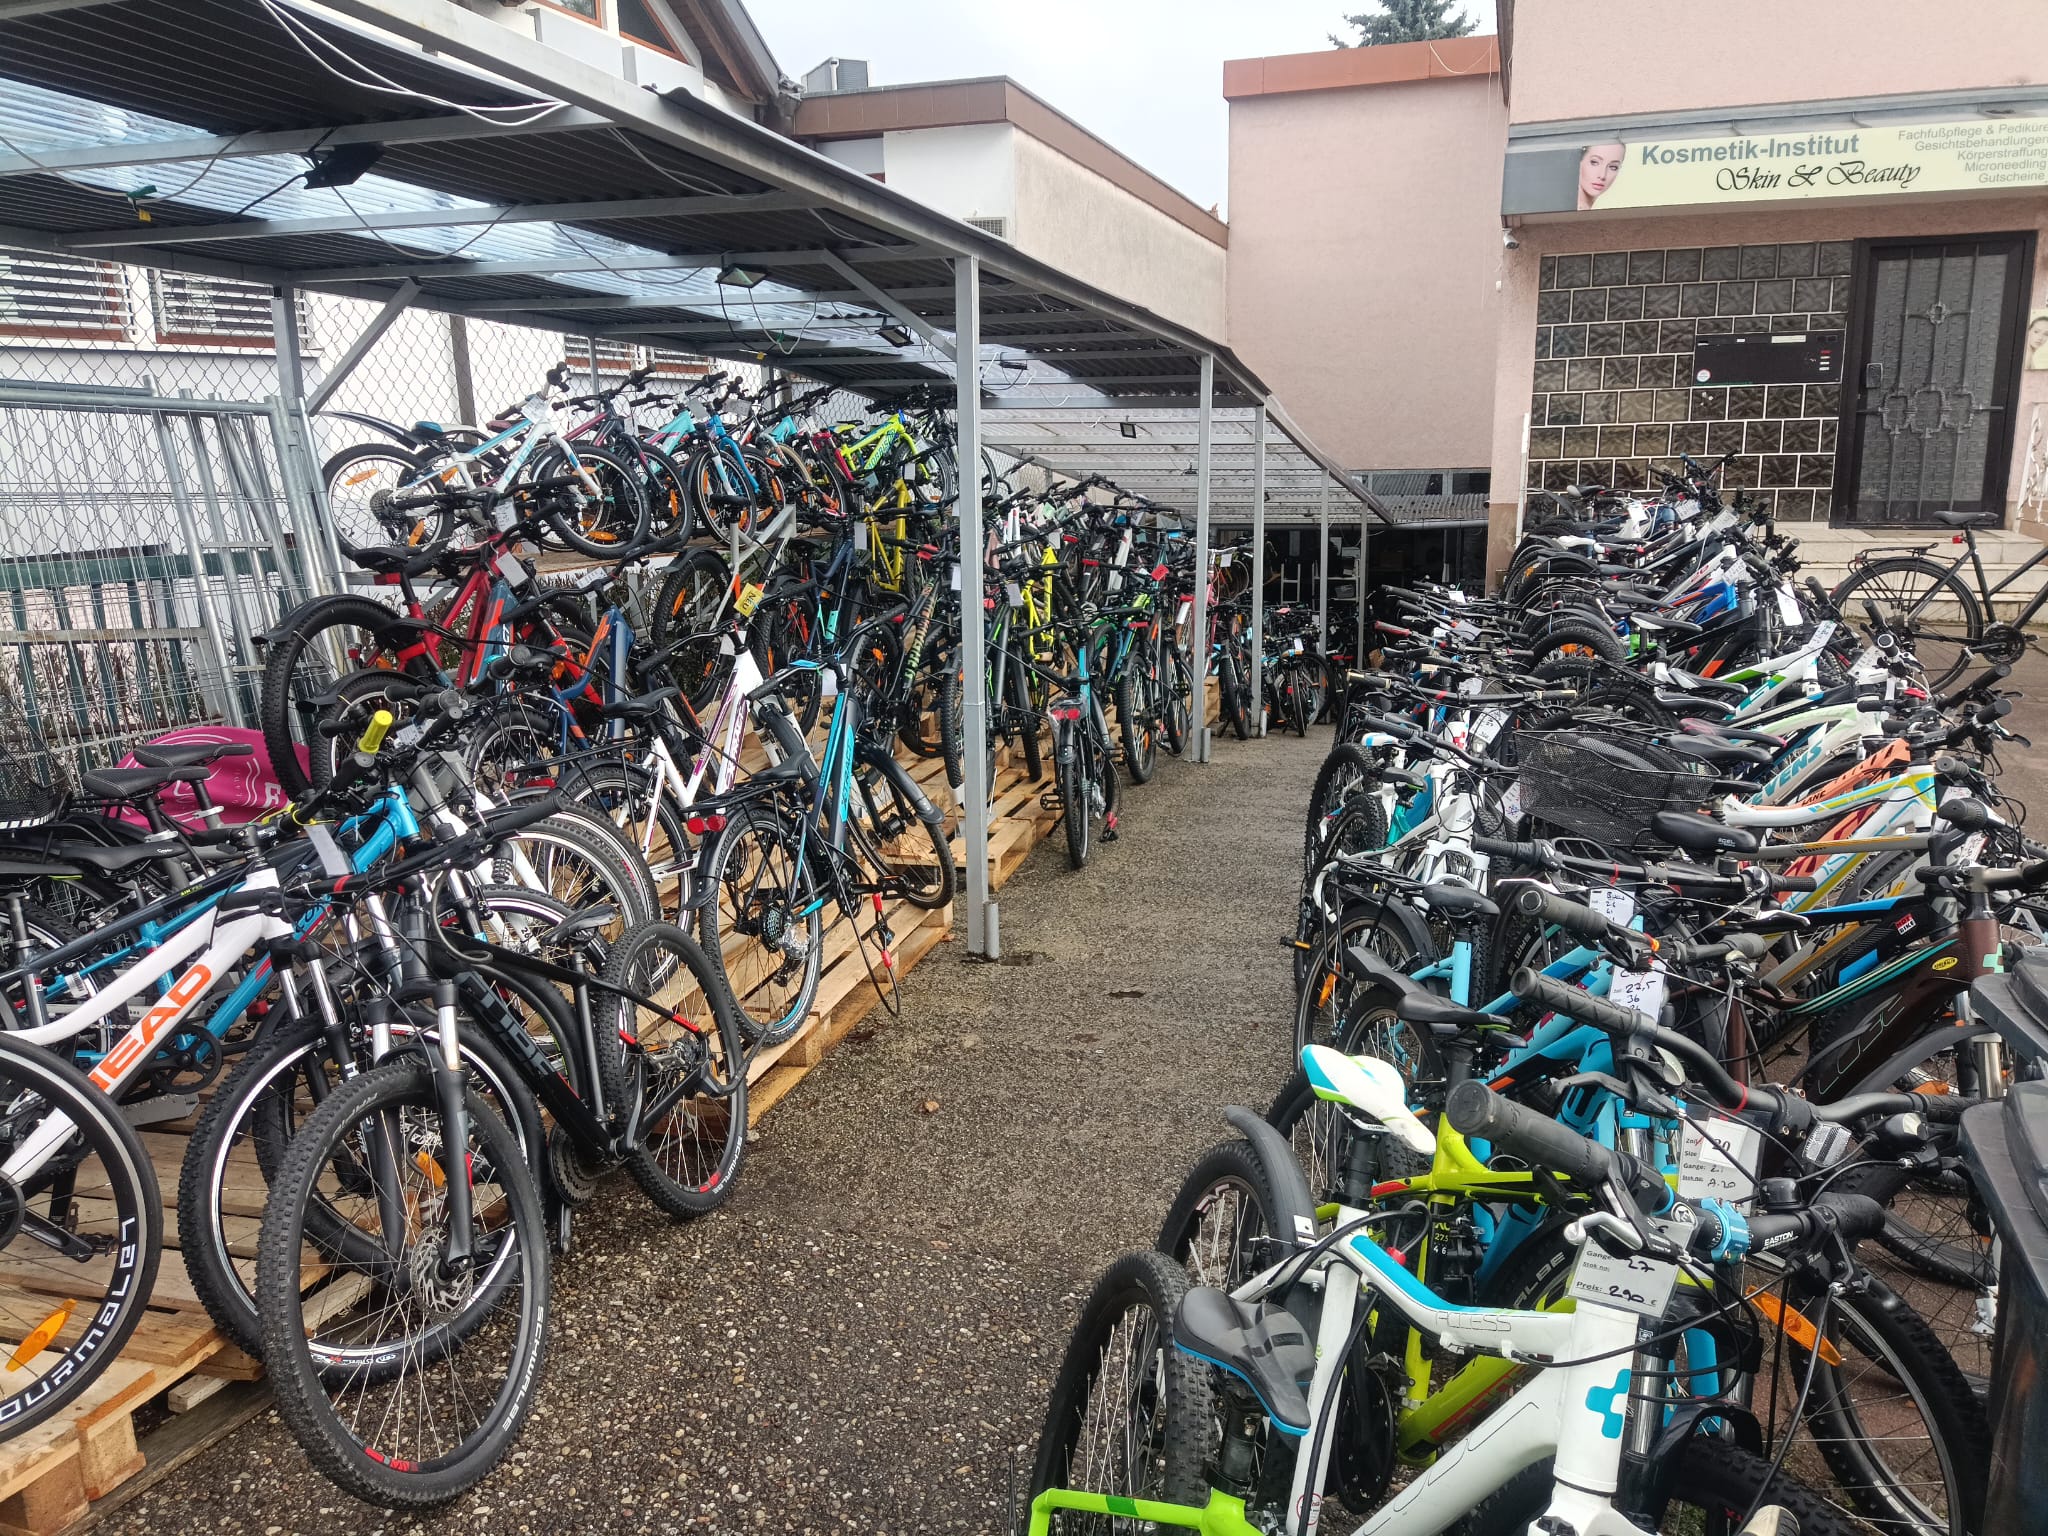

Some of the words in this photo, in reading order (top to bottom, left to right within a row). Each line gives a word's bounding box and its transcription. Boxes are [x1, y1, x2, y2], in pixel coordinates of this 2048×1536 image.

[1898, 126, 1983, 141] Fachfußpflege
[1986, 125, 1994, 135] &
[1642, 133, 1860, 165] Kosmetik-Institut
[1914, 135, 2048, 151] Gesichtsbehandlungen
[1965, 159, 2047, 172] Microneedling
[1716, 166, 1782, 191] Skin
[1787, 164, 1824, 188] &
[1826, 160, 1922, 190] Beauty
[1978, 172, 2046, 184] Gutscheine
[1751, 740, 1822, 806] EVENS
[1764, 1230, 1794, 1246] EASTON
[1513, 1251, 1566, 1308] ALBE
